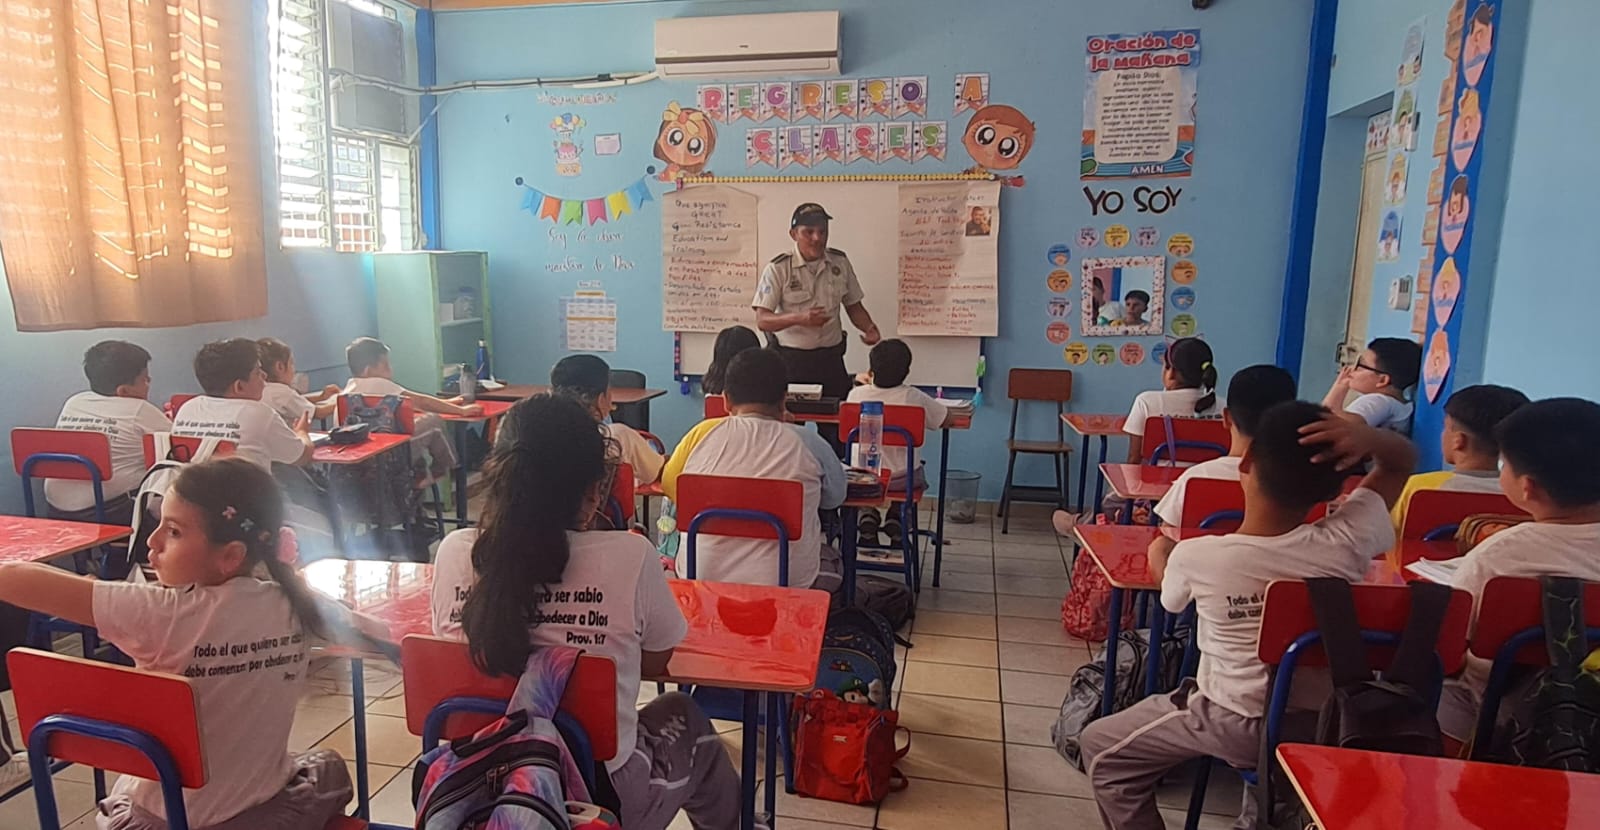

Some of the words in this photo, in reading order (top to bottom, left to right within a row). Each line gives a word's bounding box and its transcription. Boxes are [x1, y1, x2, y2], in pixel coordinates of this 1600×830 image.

[1088, 32, 1167, 53] Oración
[1170, 31, 1195, 48] de
[1090, 54, 1109, 70] la
[701, 79, 923, 110] REGRESO
[961, 76, 983, 101] A
[752, 124, 942, 153] CLASES
[1083, 186, 1124, 216] YO
[1133, 185, 1182, 214] SOY
[455, 586, 472, 602] Tod
[554, 591, 570, 603] ser
[573, 587, 603, 604] sabio
[578, 616, 586, 626] a
[588, 610, 608, 627] Dios
[566, 631, 593, 645] Prov.
[594, 634, 606, 645] 1:7
[193, 643, 217, 658] Todo
[219, 642, 228, 656] el
[231, 643, 248, 656] que
[184, 664, 206, 678] debe
[249, 659, 262, 672] por
